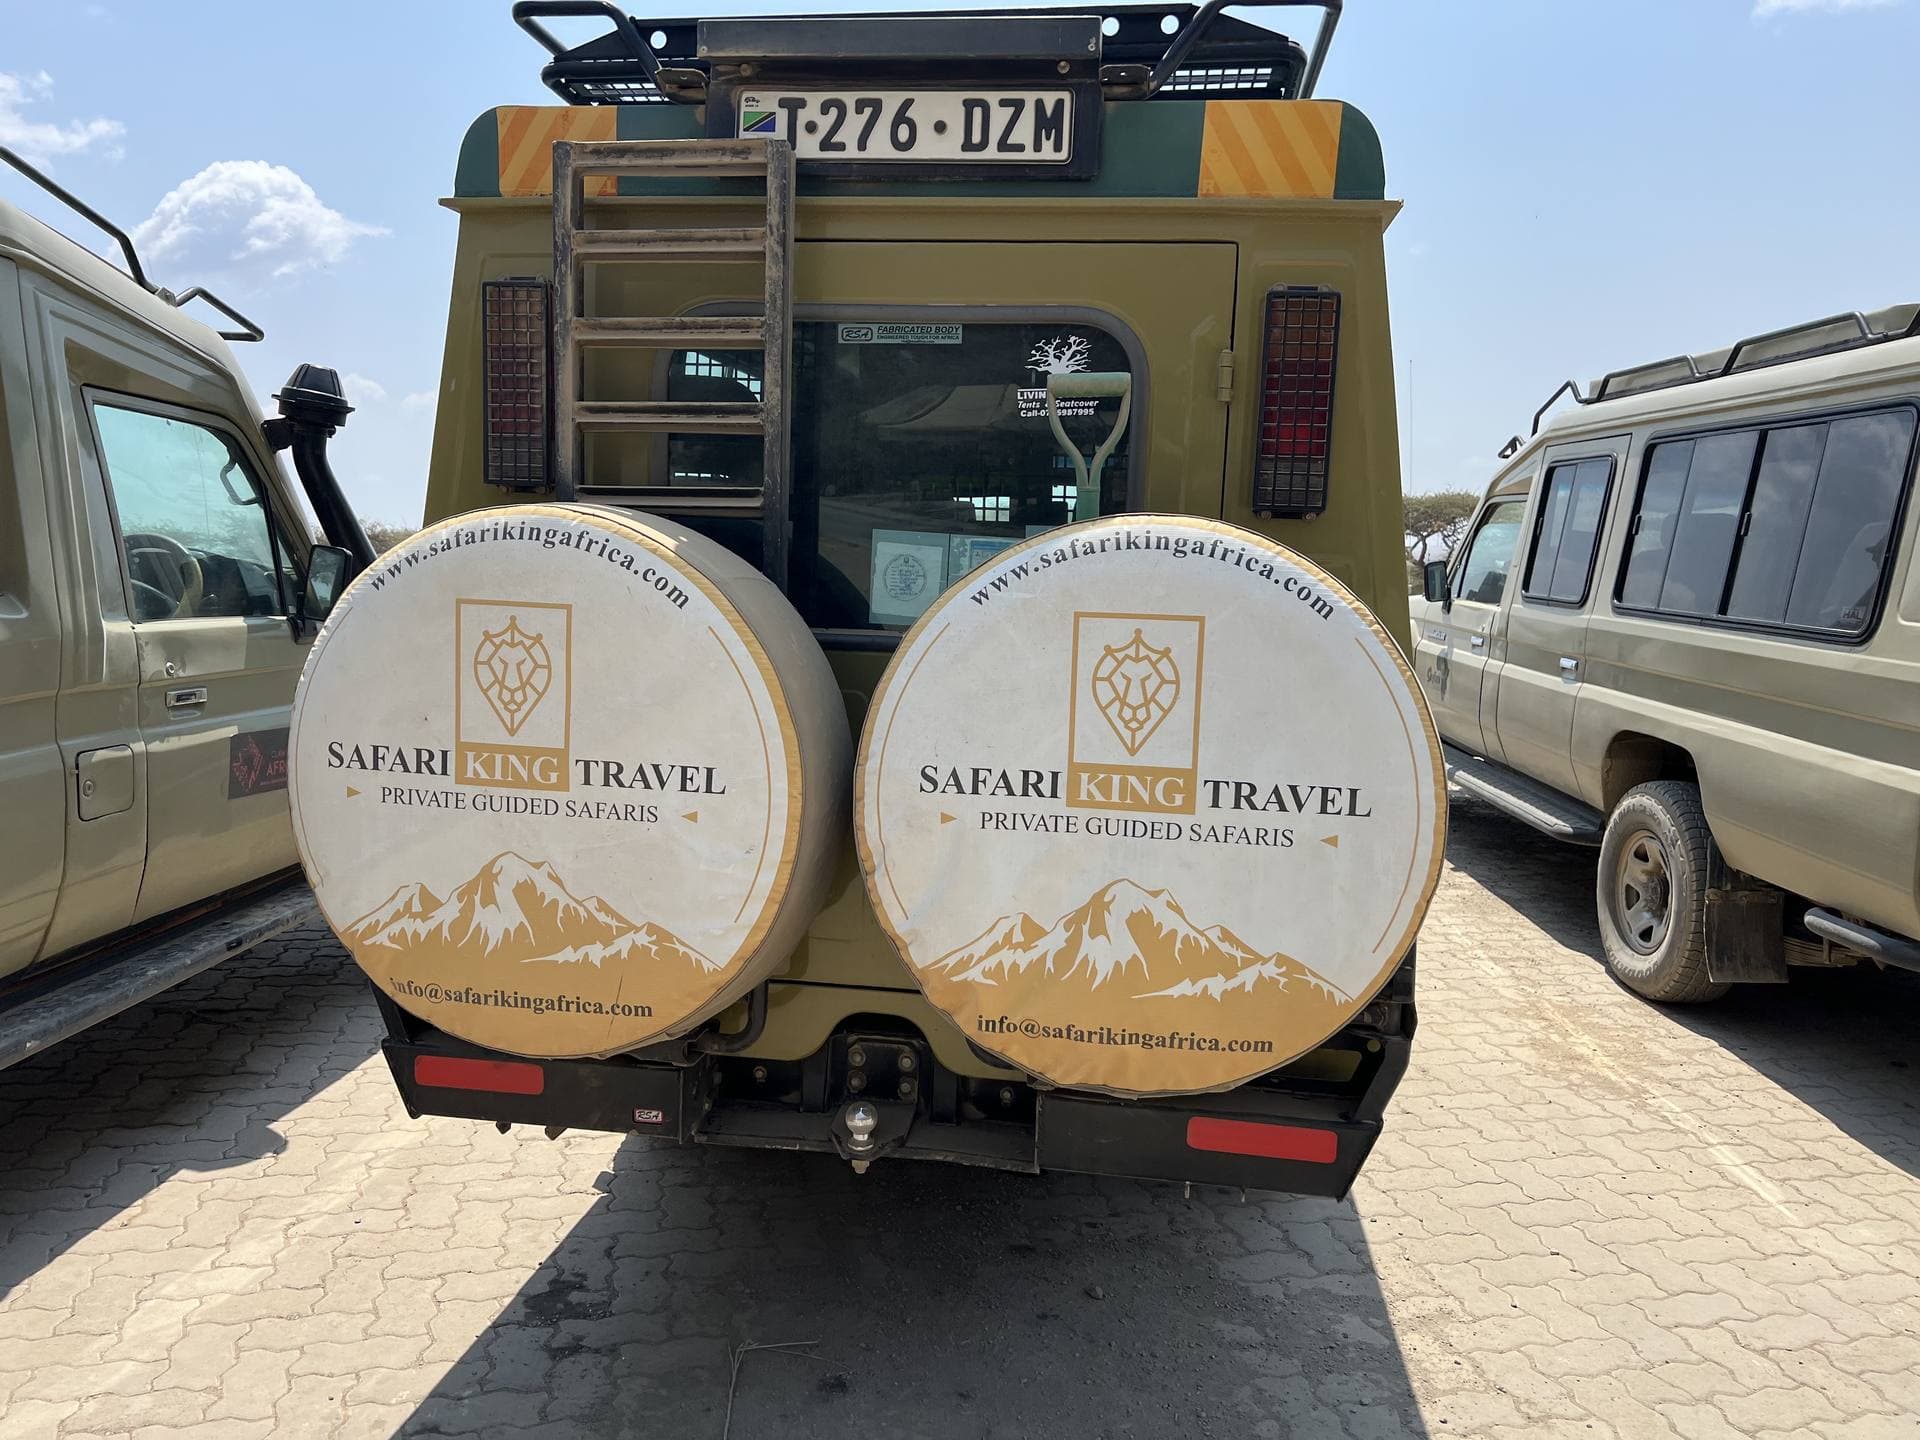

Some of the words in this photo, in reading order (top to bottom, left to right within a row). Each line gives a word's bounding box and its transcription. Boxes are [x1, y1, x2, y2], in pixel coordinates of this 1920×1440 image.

[819, 98, 917, 152] 276
[961, 98, 1065, 152] DZM
[877, 326, 932, 334] FABRICATED
[934, 326, 961, 334] BODY
[1017, 391, 1047, 399] LIVIN
[1018, 401, 1040, 409] Tents
[1055, 400, 1099, 408] Seatcover
[370, 520, 690, 611] www.safarikingafrica.com
[970, 530, 1335, 621] www.safarikingafrica.com
[327, 741, 451, 777] SAFARI
[463, 751, 560, 785] KING
[575, 758, 727, 795] TRAVEL
[381, 786, 466, 810] PRIVATE
[472, 794, 559, 816] GUIDED
[565, 800, 659, 823] SAFARIS
[919, 765, 1062, 800] SAFARI
[1077, 771, 1185, 808] KING
[1203, 779, 1372, 818] TRAVEL
[980, 811, 1079, 835] PRIVATE
[1085, 818, 1183, 841] GUIDED
[1189, 823, 1295, 848] SAFARIS
[389, 977, 654, 1017] info@safarikingafrica.com
[976, 1014, 1274, 1054] info@safarikingafrica.com
